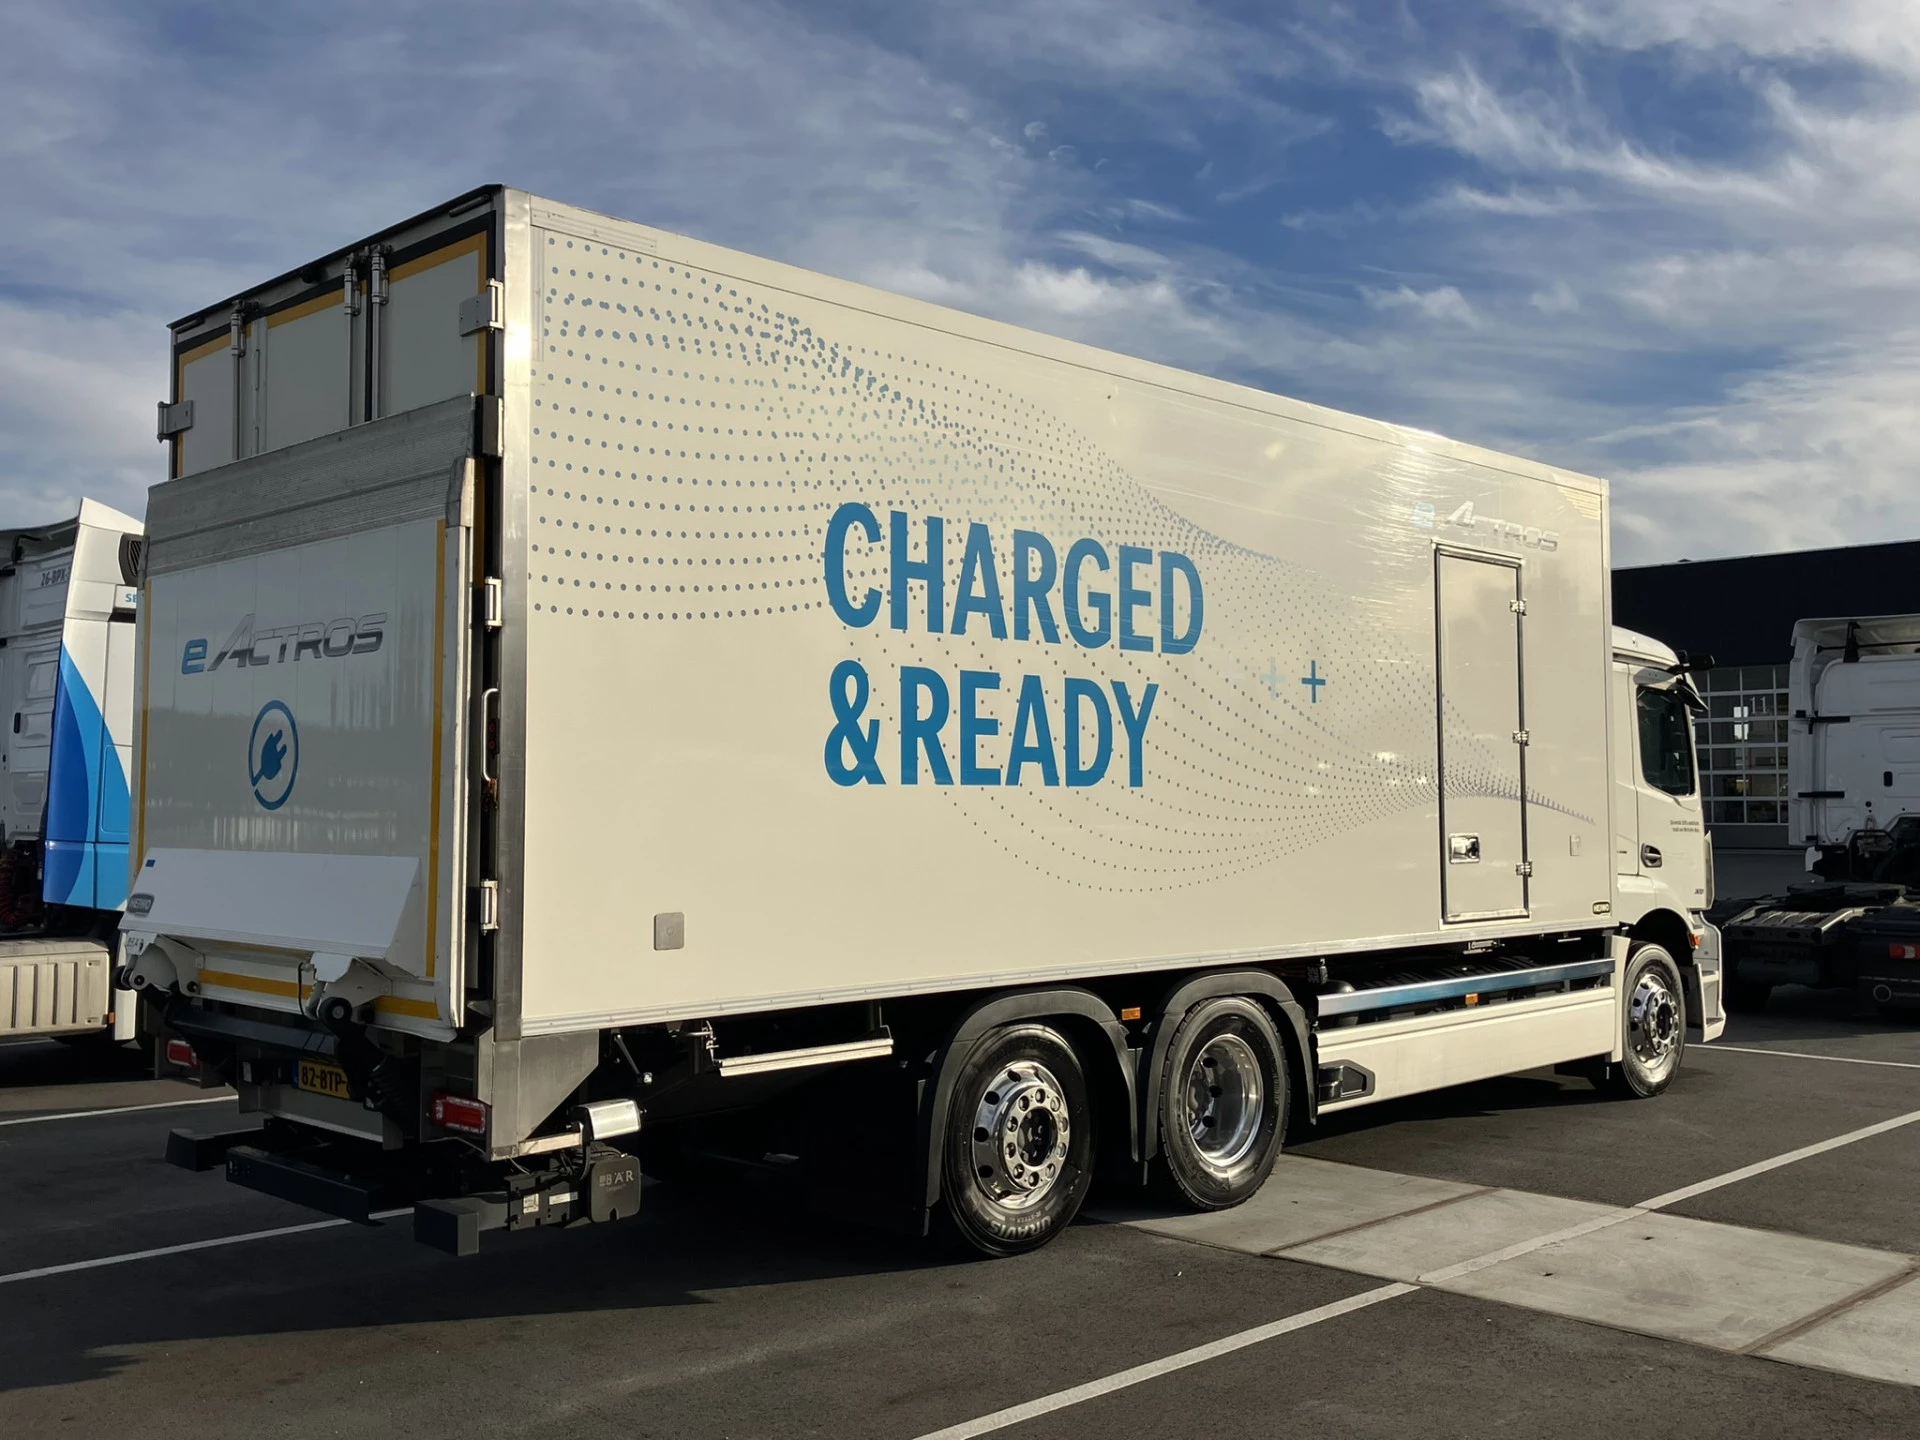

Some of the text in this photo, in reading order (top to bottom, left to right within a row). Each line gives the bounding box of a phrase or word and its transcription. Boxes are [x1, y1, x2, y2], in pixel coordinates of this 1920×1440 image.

[824, 502, 1203, 655] CHARGED
[824, 660, 1159, 787] & READY
[301, 1065, 350, 1093] 82-BTP-
[606, 1170, 634, 1186] BÄR
